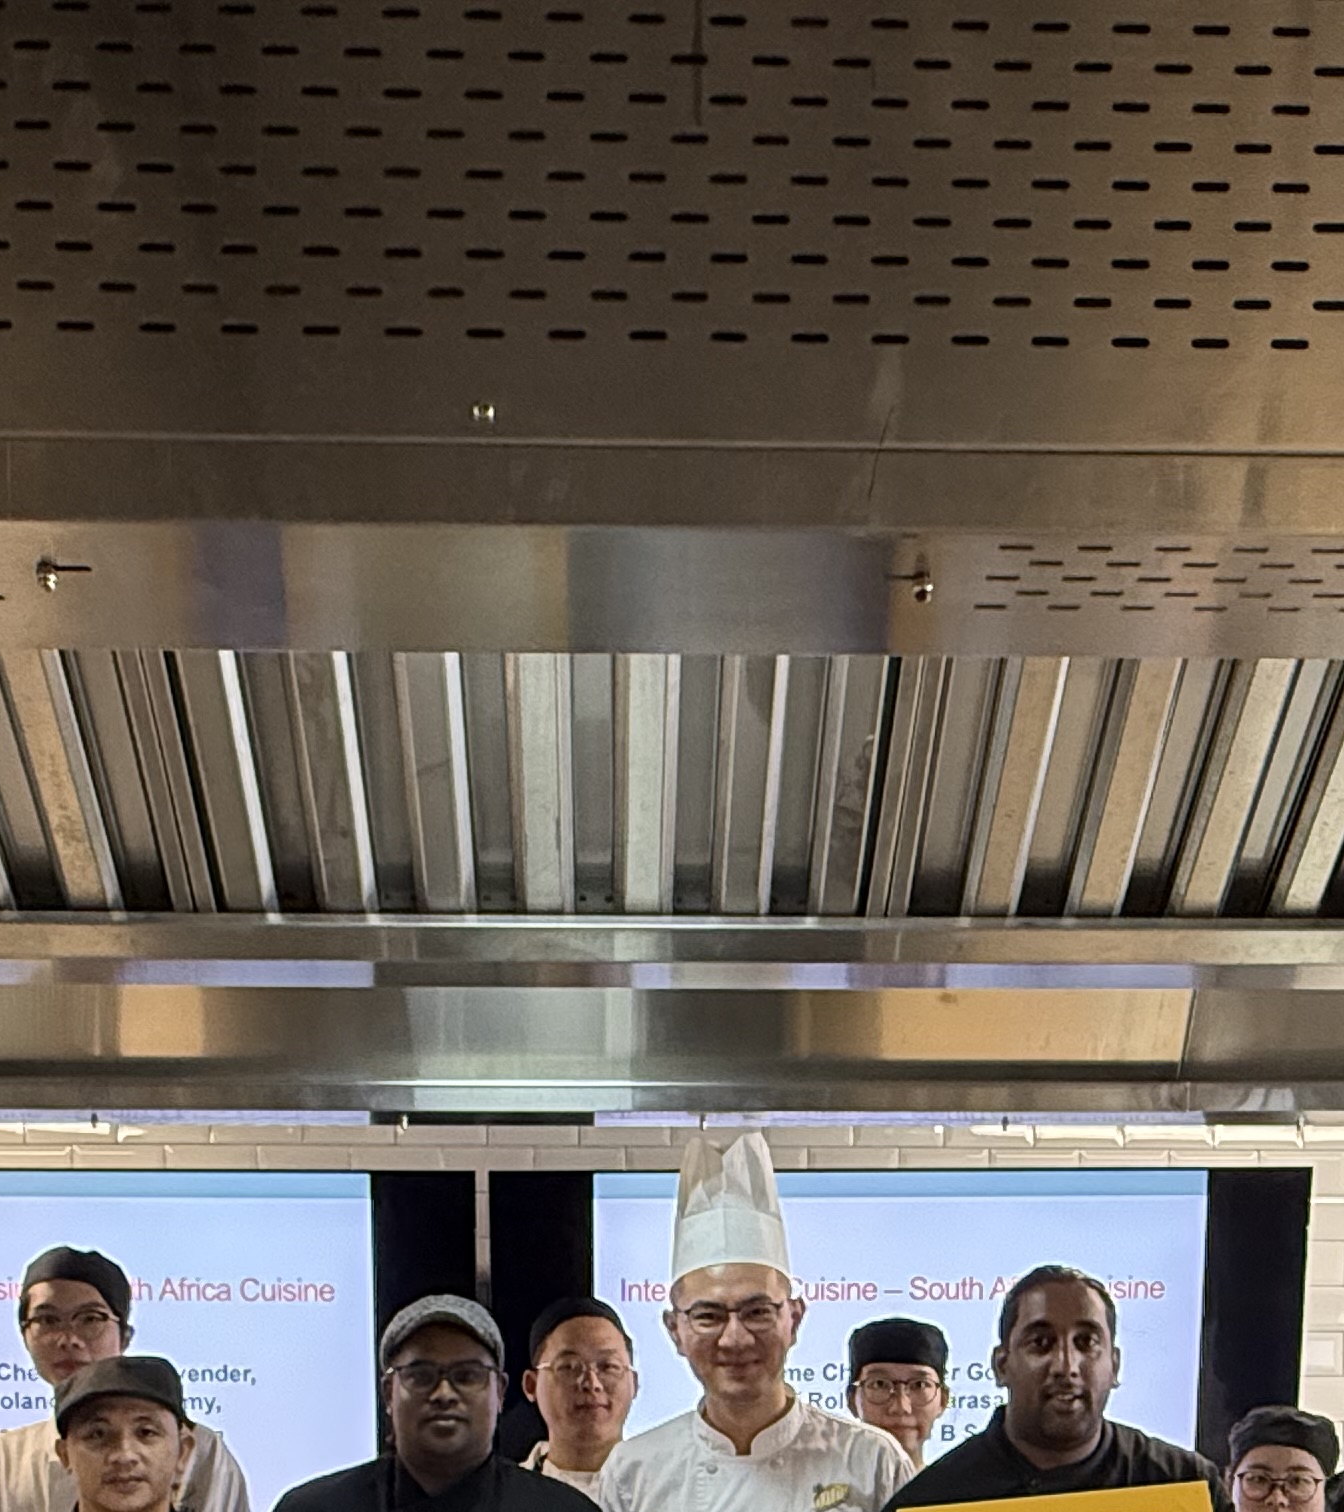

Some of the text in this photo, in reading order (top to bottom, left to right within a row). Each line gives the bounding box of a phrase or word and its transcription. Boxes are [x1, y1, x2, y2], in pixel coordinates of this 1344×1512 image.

[159, 1276, 231, 1301] Africa
[239, 1276, 336, 1302] Cuisine
[908, 1276, 984, 1301] South
[1107, 1274, 1166, 1300] isine
